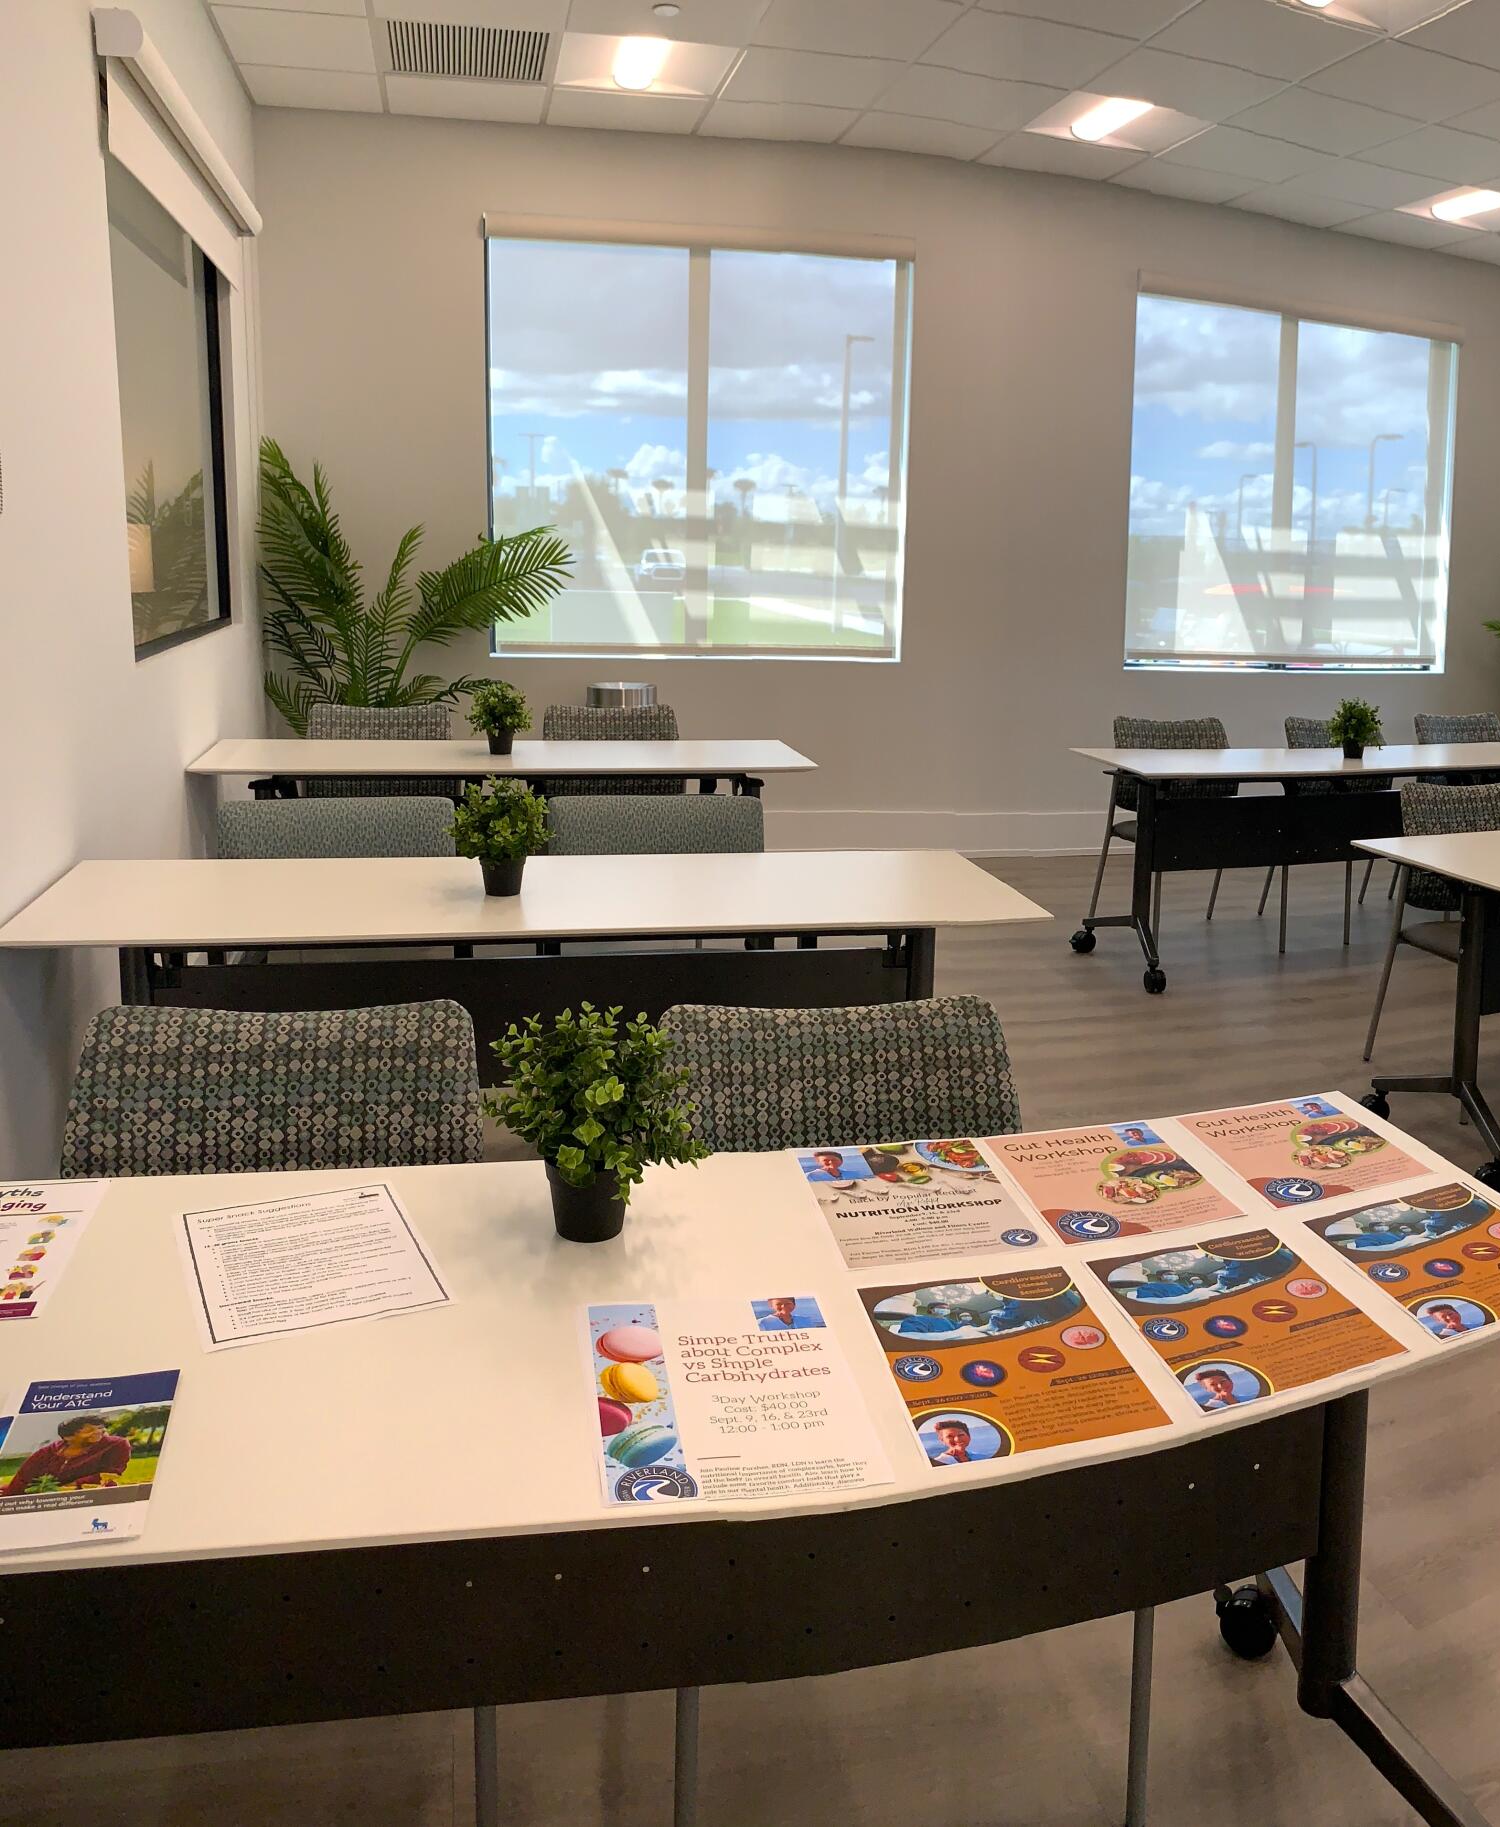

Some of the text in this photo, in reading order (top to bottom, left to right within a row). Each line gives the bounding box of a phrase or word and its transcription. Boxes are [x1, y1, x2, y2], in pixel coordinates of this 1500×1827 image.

[1195, 1109, 1295, 1129] Gut Health
[1205, 1118, 1302, 1138] Workshop
[1003, 1133, 1113, 1152] Gut Health
[1011, 1144, 1118, 1163] Workshop
[892, 1192, 931, 1201] Popular
[0, 1199, 47, 1212] ging
[836, 1204, 919, 1219] NUTRITION
[921, 1198, 1002, 1211] WORKSHOP
[742, 1330, 810, 1344] Truths
[736, 1342, 823, 1357] Complex
[683, 1360, 706, 1370] vs
[34, 1389, 113, 1402] Understand
[750, 1390, 821, 1403] Workshop
[31, 1399, 92, 1410] Your A1C
[724, 1405, 758, 1414] Cost:
[709, 1415, 742, 1424] Sept.
[784, 1411, 794, 1420] &
[798, 1408, 828, 1419] 23rd
[719, 1424, 757, 1434] 12:00
[771, 1421, 800, 1431] 1:00
[803, 1420, 825, 1430] pm
[620, 1467, 689, 1487] RIVERLAND
